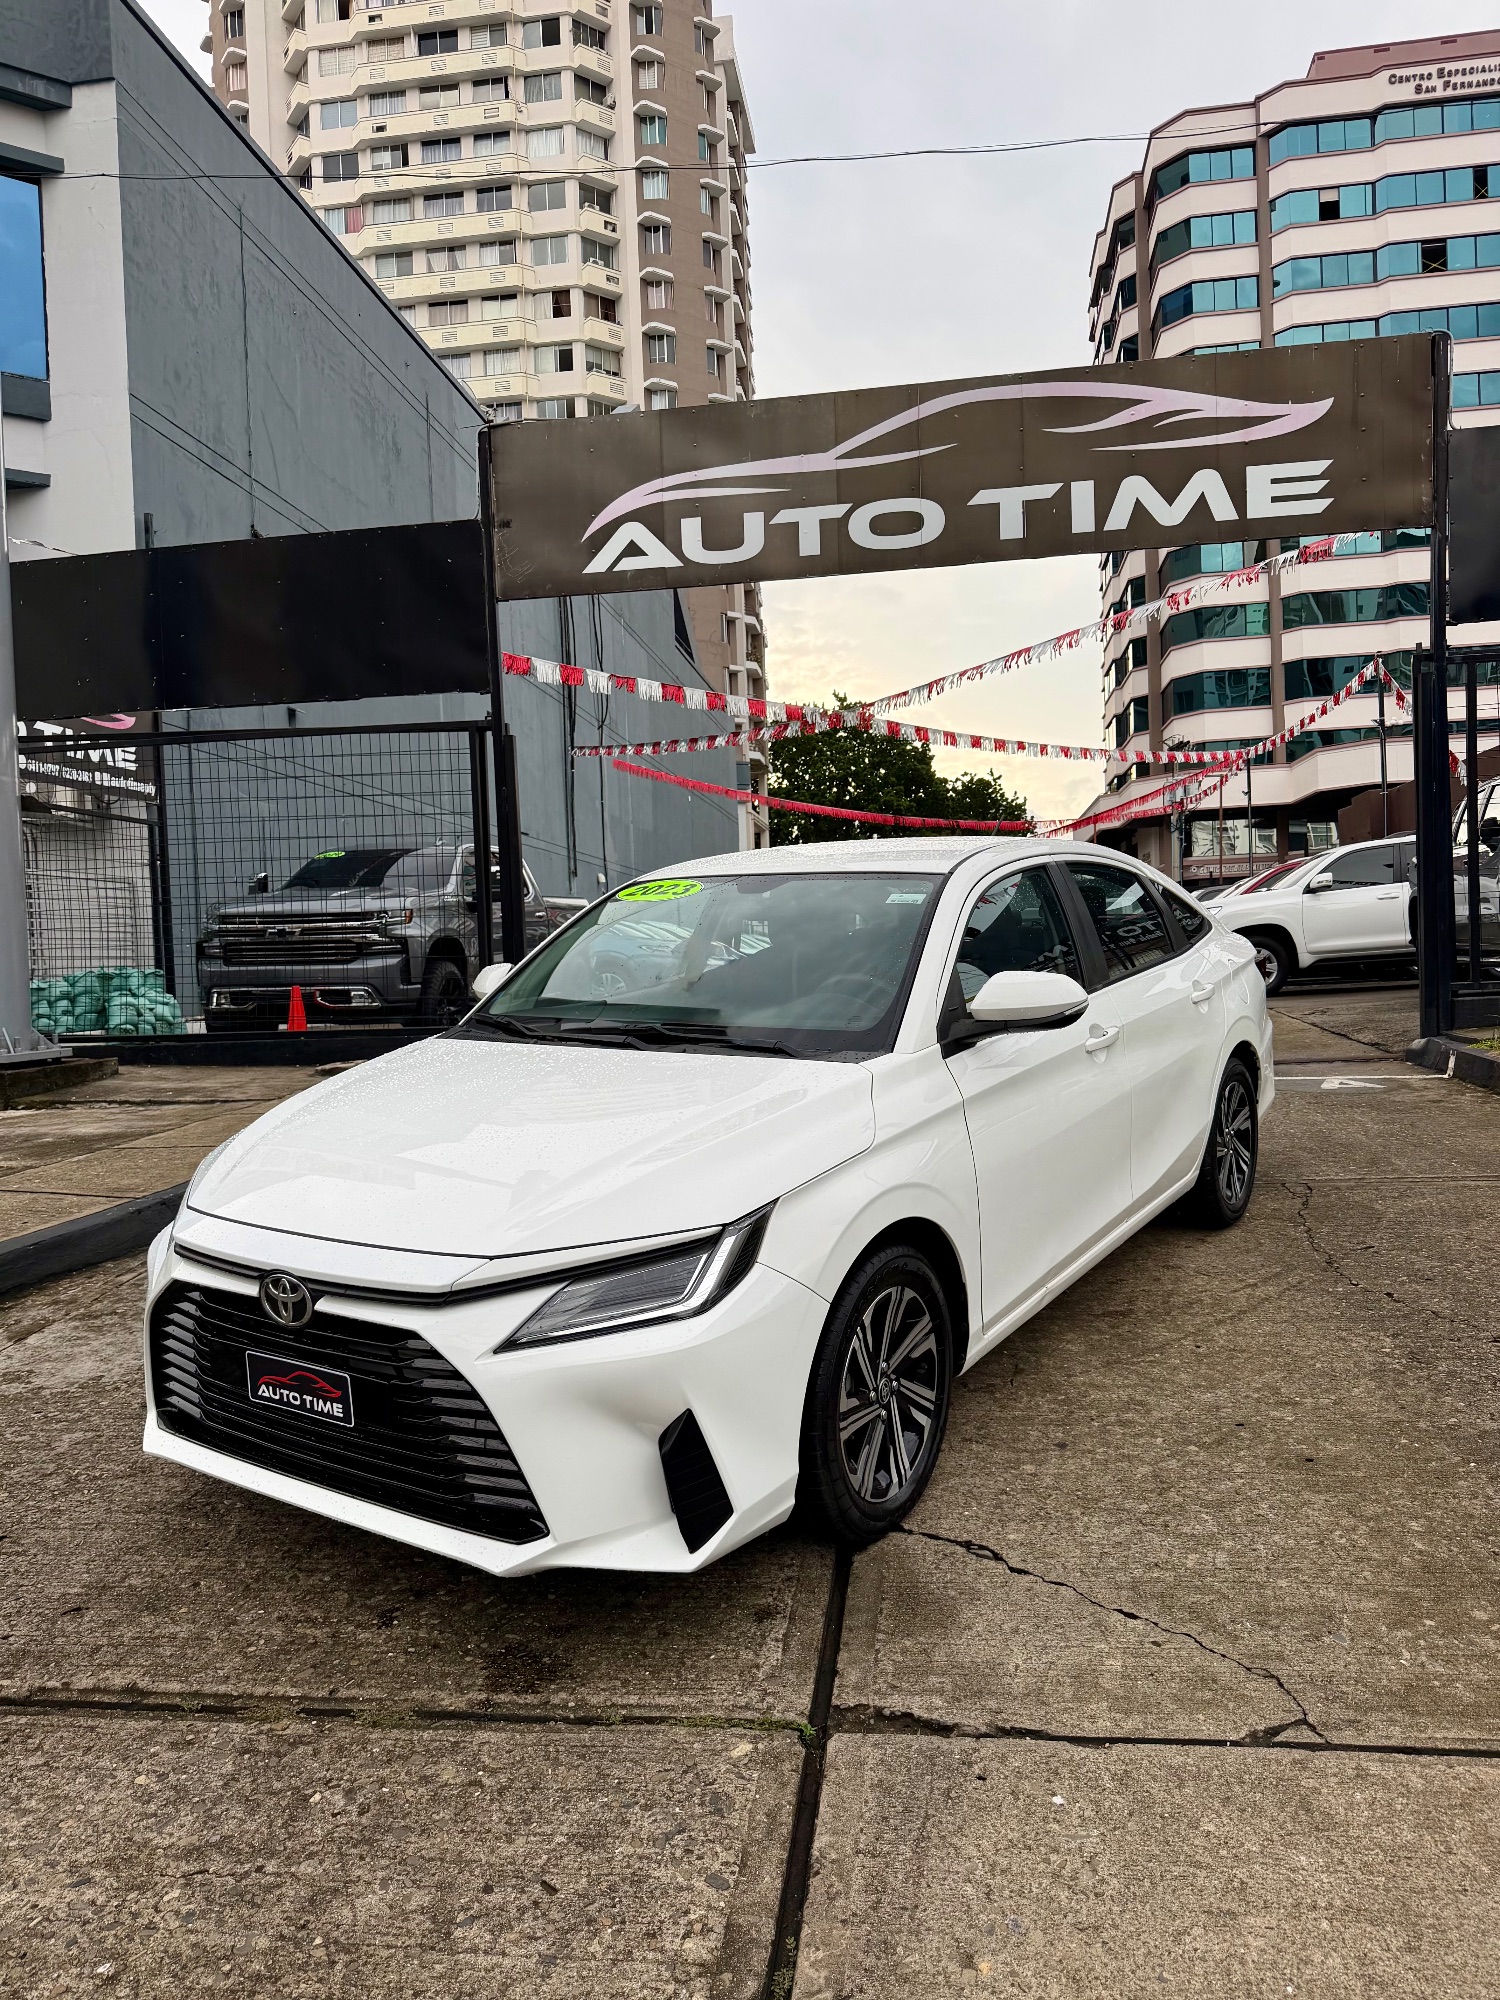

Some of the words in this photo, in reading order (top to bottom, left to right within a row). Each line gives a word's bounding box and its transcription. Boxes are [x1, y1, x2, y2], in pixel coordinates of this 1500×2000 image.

[1388, 72, 1433, 84] CENTRO
[1437, 64, 1500, 79] ESPECIALI
[1414, 82, 1437, 95] SAN
[582, 497, 946, 574] AUTO
[966, 459, 1335, 540] TIME
[623, 884, 698, 896] 2023
[258, 1384, 301, 1405] AUTO
[303, 1395, 344, 1417] TIME
